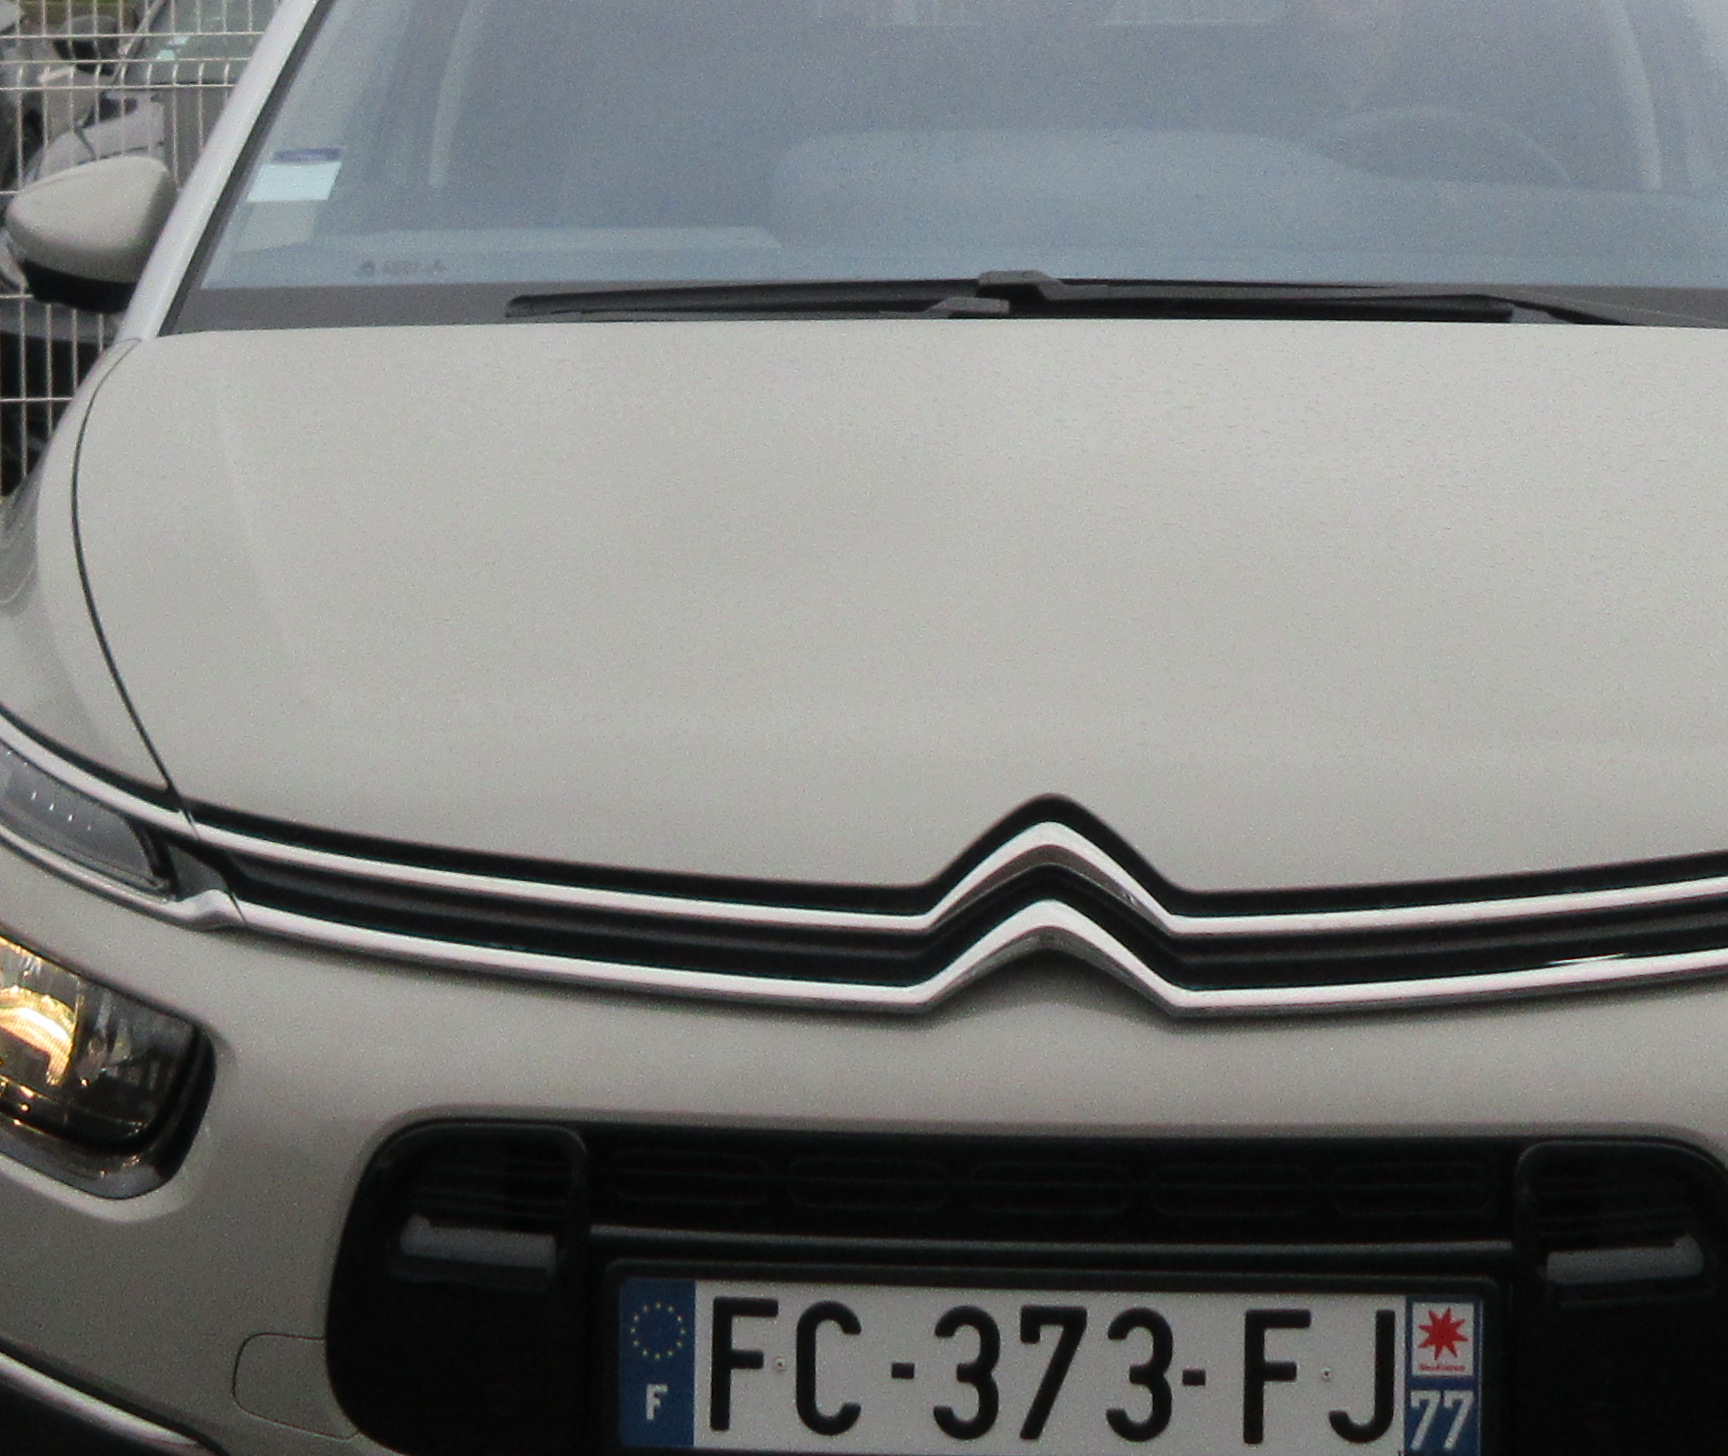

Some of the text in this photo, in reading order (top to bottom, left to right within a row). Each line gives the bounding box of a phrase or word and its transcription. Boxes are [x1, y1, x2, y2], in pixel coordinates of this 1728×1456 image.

[709, 1295, 1396, 1445] FC-373-FJ
[645, 1383, 669, 1421] F
[1410, 1389, 1474, 1451] 77
